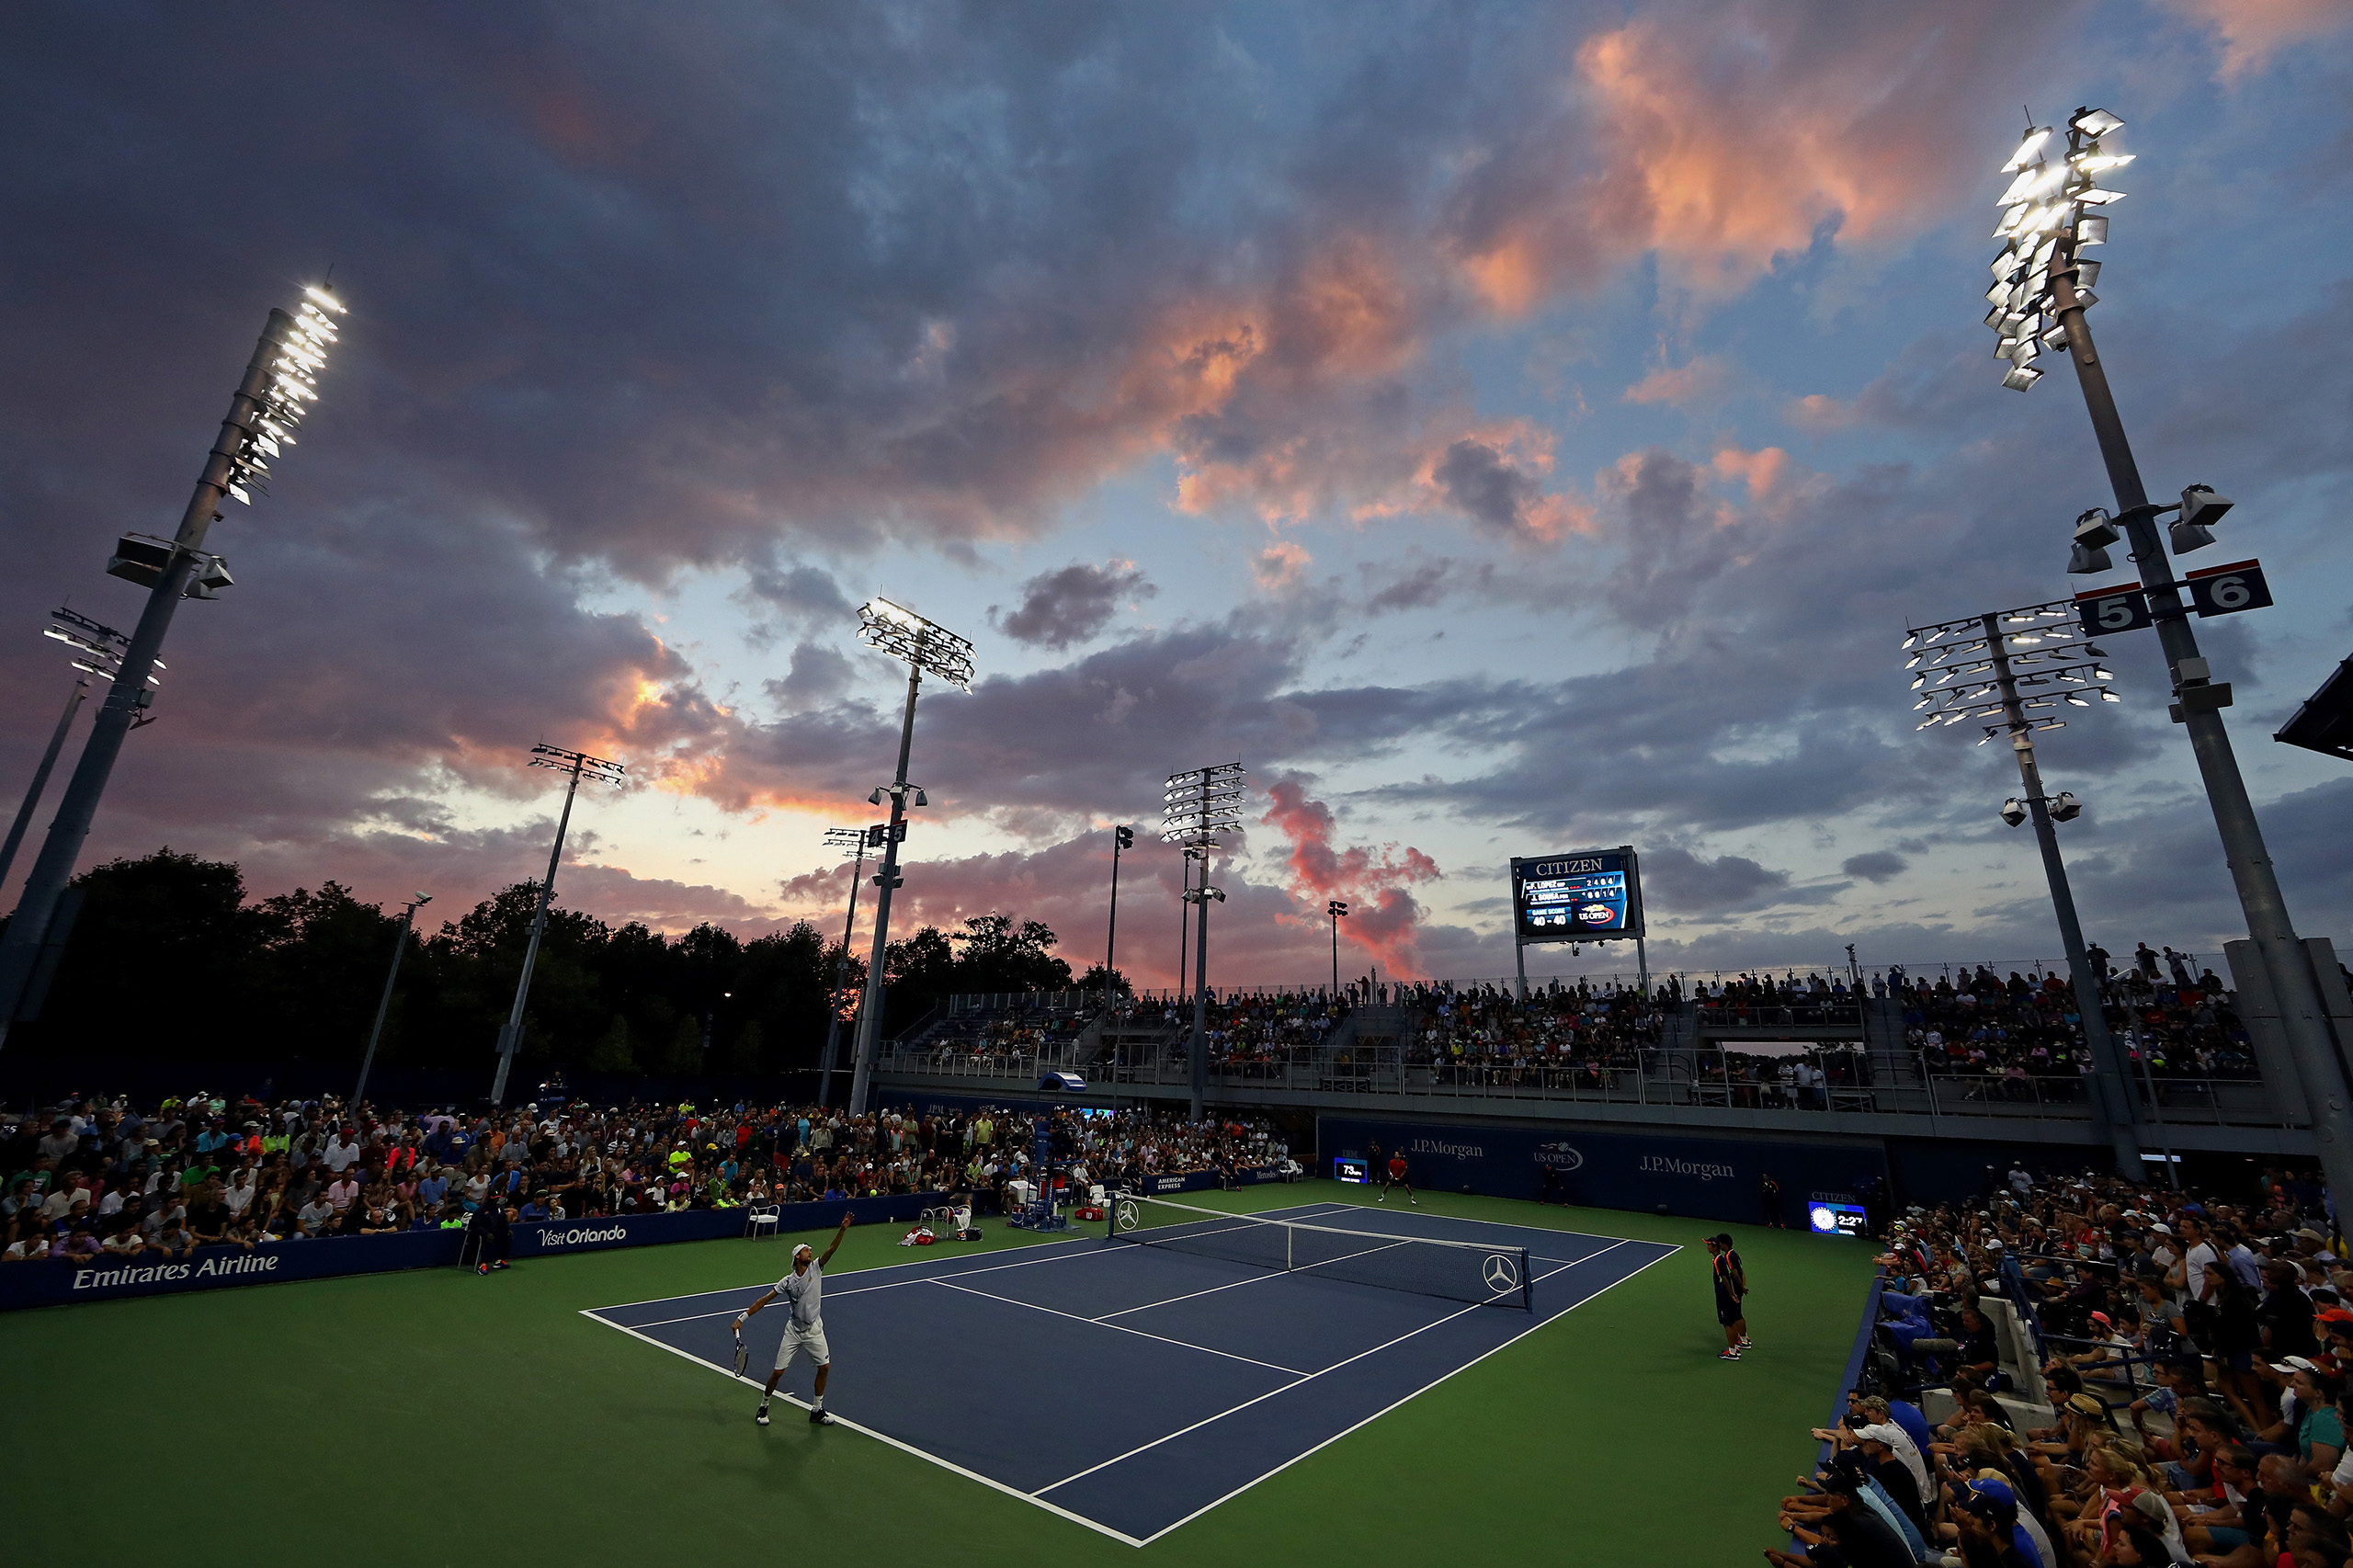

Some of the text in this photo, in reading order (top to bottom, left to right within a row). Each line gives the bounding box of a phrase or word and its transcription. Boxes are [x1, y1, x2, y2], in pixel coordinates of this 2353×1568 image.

[2210, 576, 2250, 608] 6
[2097, 597, 2133, 629] 5
[870, 830, 879, 845] 4
[893, 825, 903, 841] 5
[1536, 858, 1603, 876] CITIZEN
[1538, 881, 1556, 889] LOPEZ
[1533, 916, 1545, 926] 40
[1553, 915, 1566, 925] 40
[1342, 1149, 1358, 1158] IBM
[1411, 1139, 1483, 1160] J.P.Morgan
[1533, 1153, 1575, 1164] US OPEN
[1343, 1165, 1355, 1175] 73
[1639, 1155, 1735, 1181] J.P.Morgan
[1812, 1191, 1856, 1203] CITIZEN
[1837, 1215, 1863, 1226] 2:27
[537, 1224, 627, 1246] Visit Orlando
[73, 1254, 279, 1290] Emirates Airline
